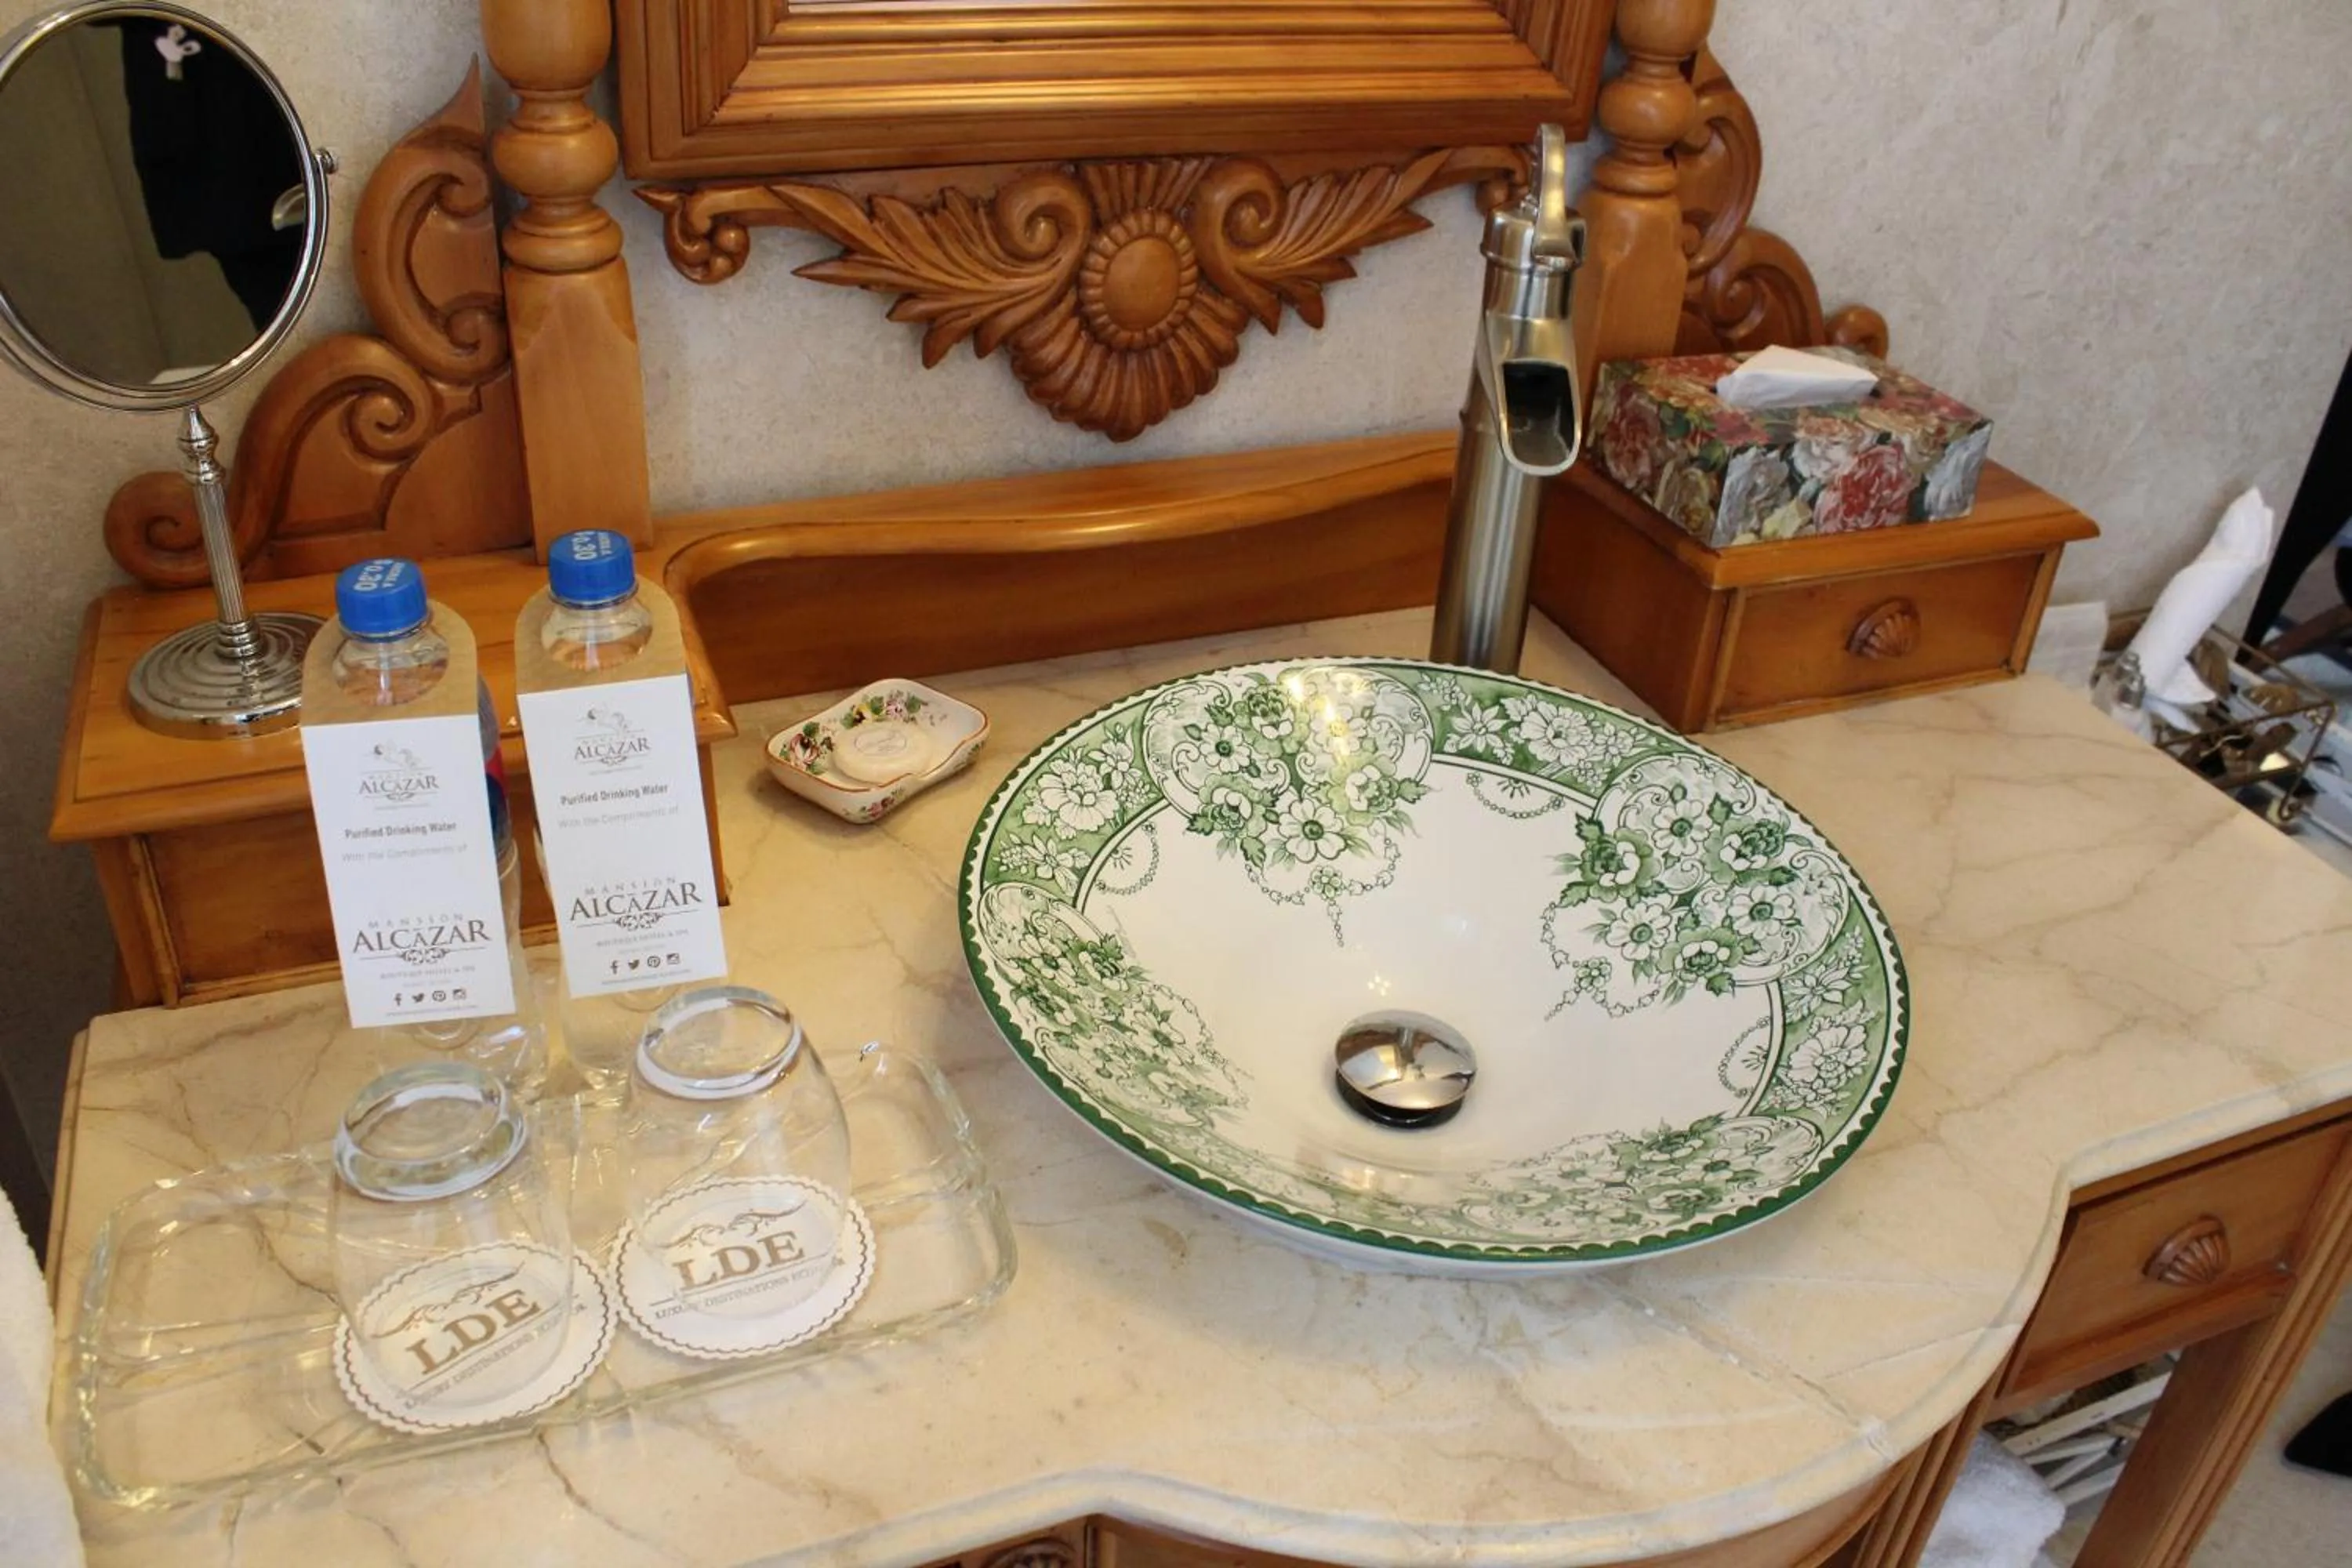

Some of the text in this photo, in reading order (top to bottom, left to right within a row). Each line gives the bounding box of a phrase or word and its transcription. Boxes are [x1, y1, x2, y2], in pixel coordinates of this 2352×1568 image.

[560, 784, 668, 806] Purified Drinking Water
[344, 822, 456, 839] Purified Drinking Water
[368, 913, 464, 929] MANSION
[672, 1230, 805, 1291] LDE
[405, 1289, 542, 1375] LDE
